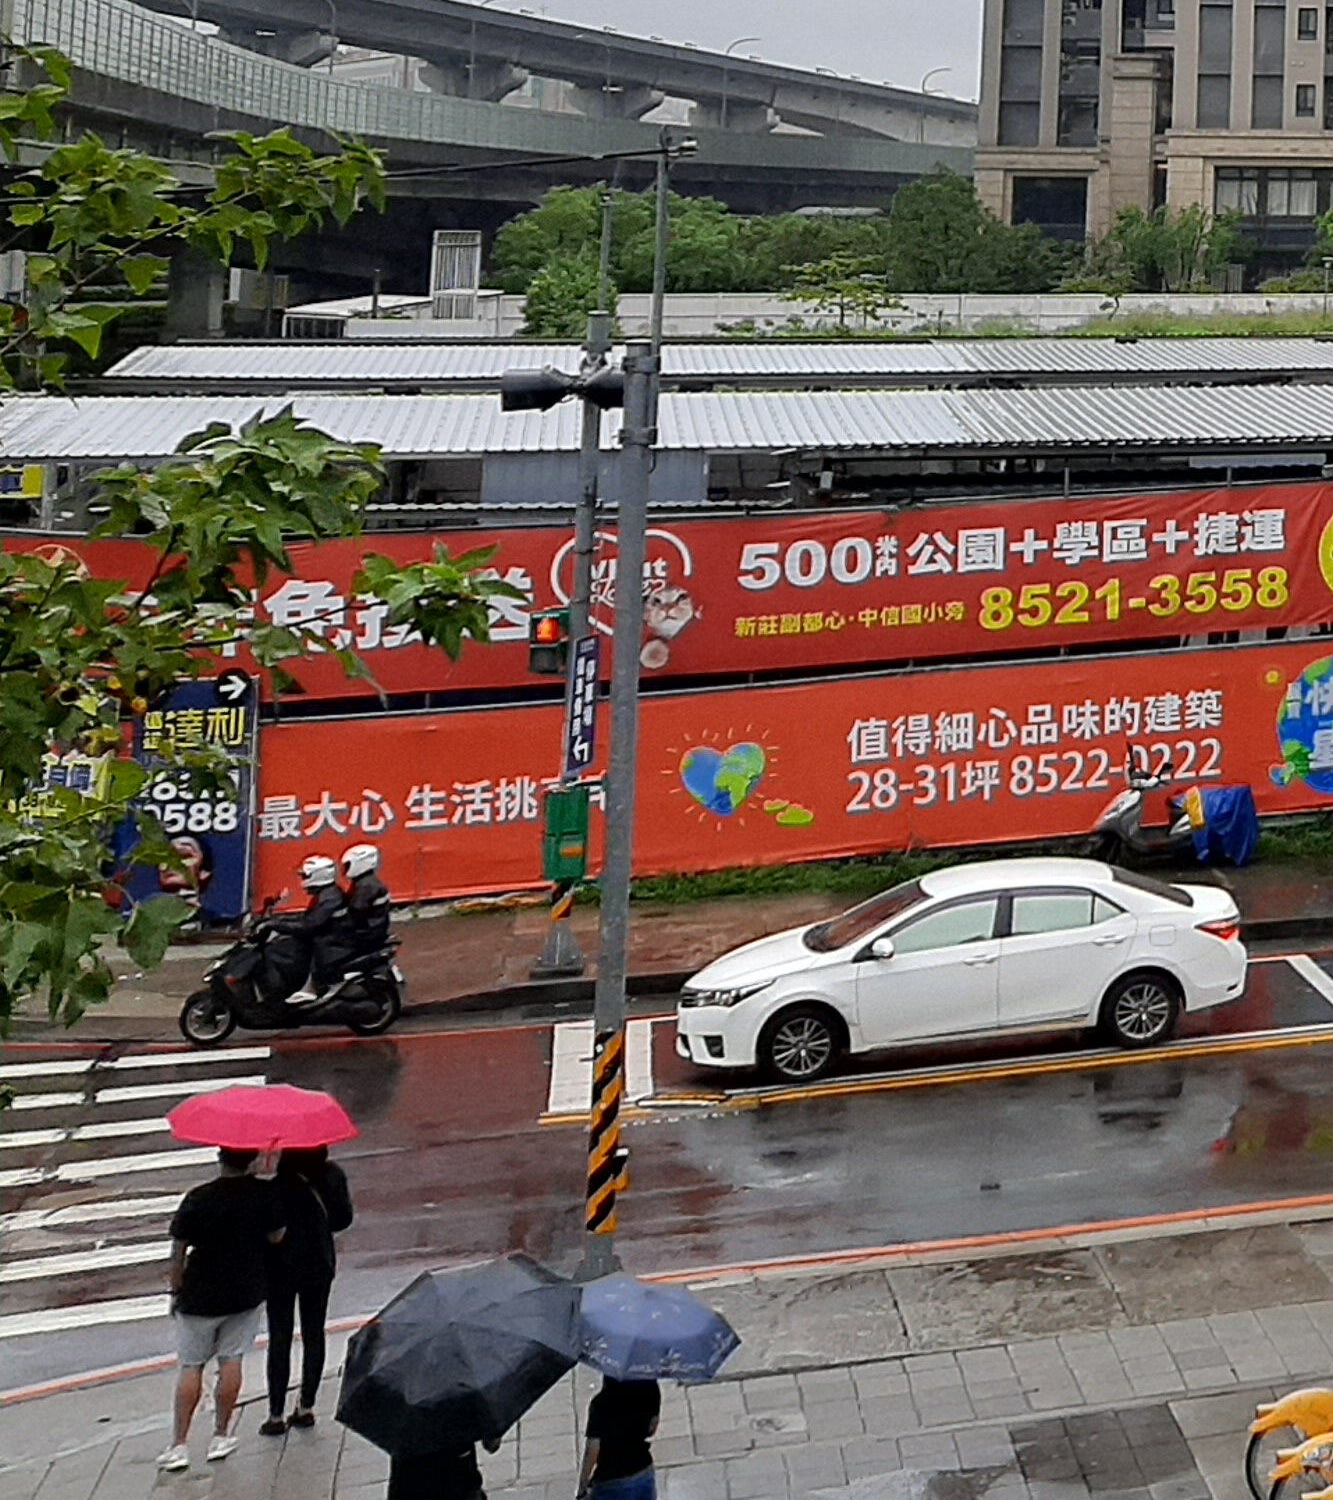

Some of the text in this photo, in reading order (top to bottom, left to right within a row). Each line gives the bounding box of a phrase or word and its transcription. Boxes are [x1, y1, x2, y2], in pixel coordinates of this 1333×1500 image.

[979, 566, 1289, 630] 8521-3558
[846, 688, 1223, 764] 值得細心品味的建築
[258, 789, 395, 840] 最大心
[845, 758, 999, 813] 28-31坪
